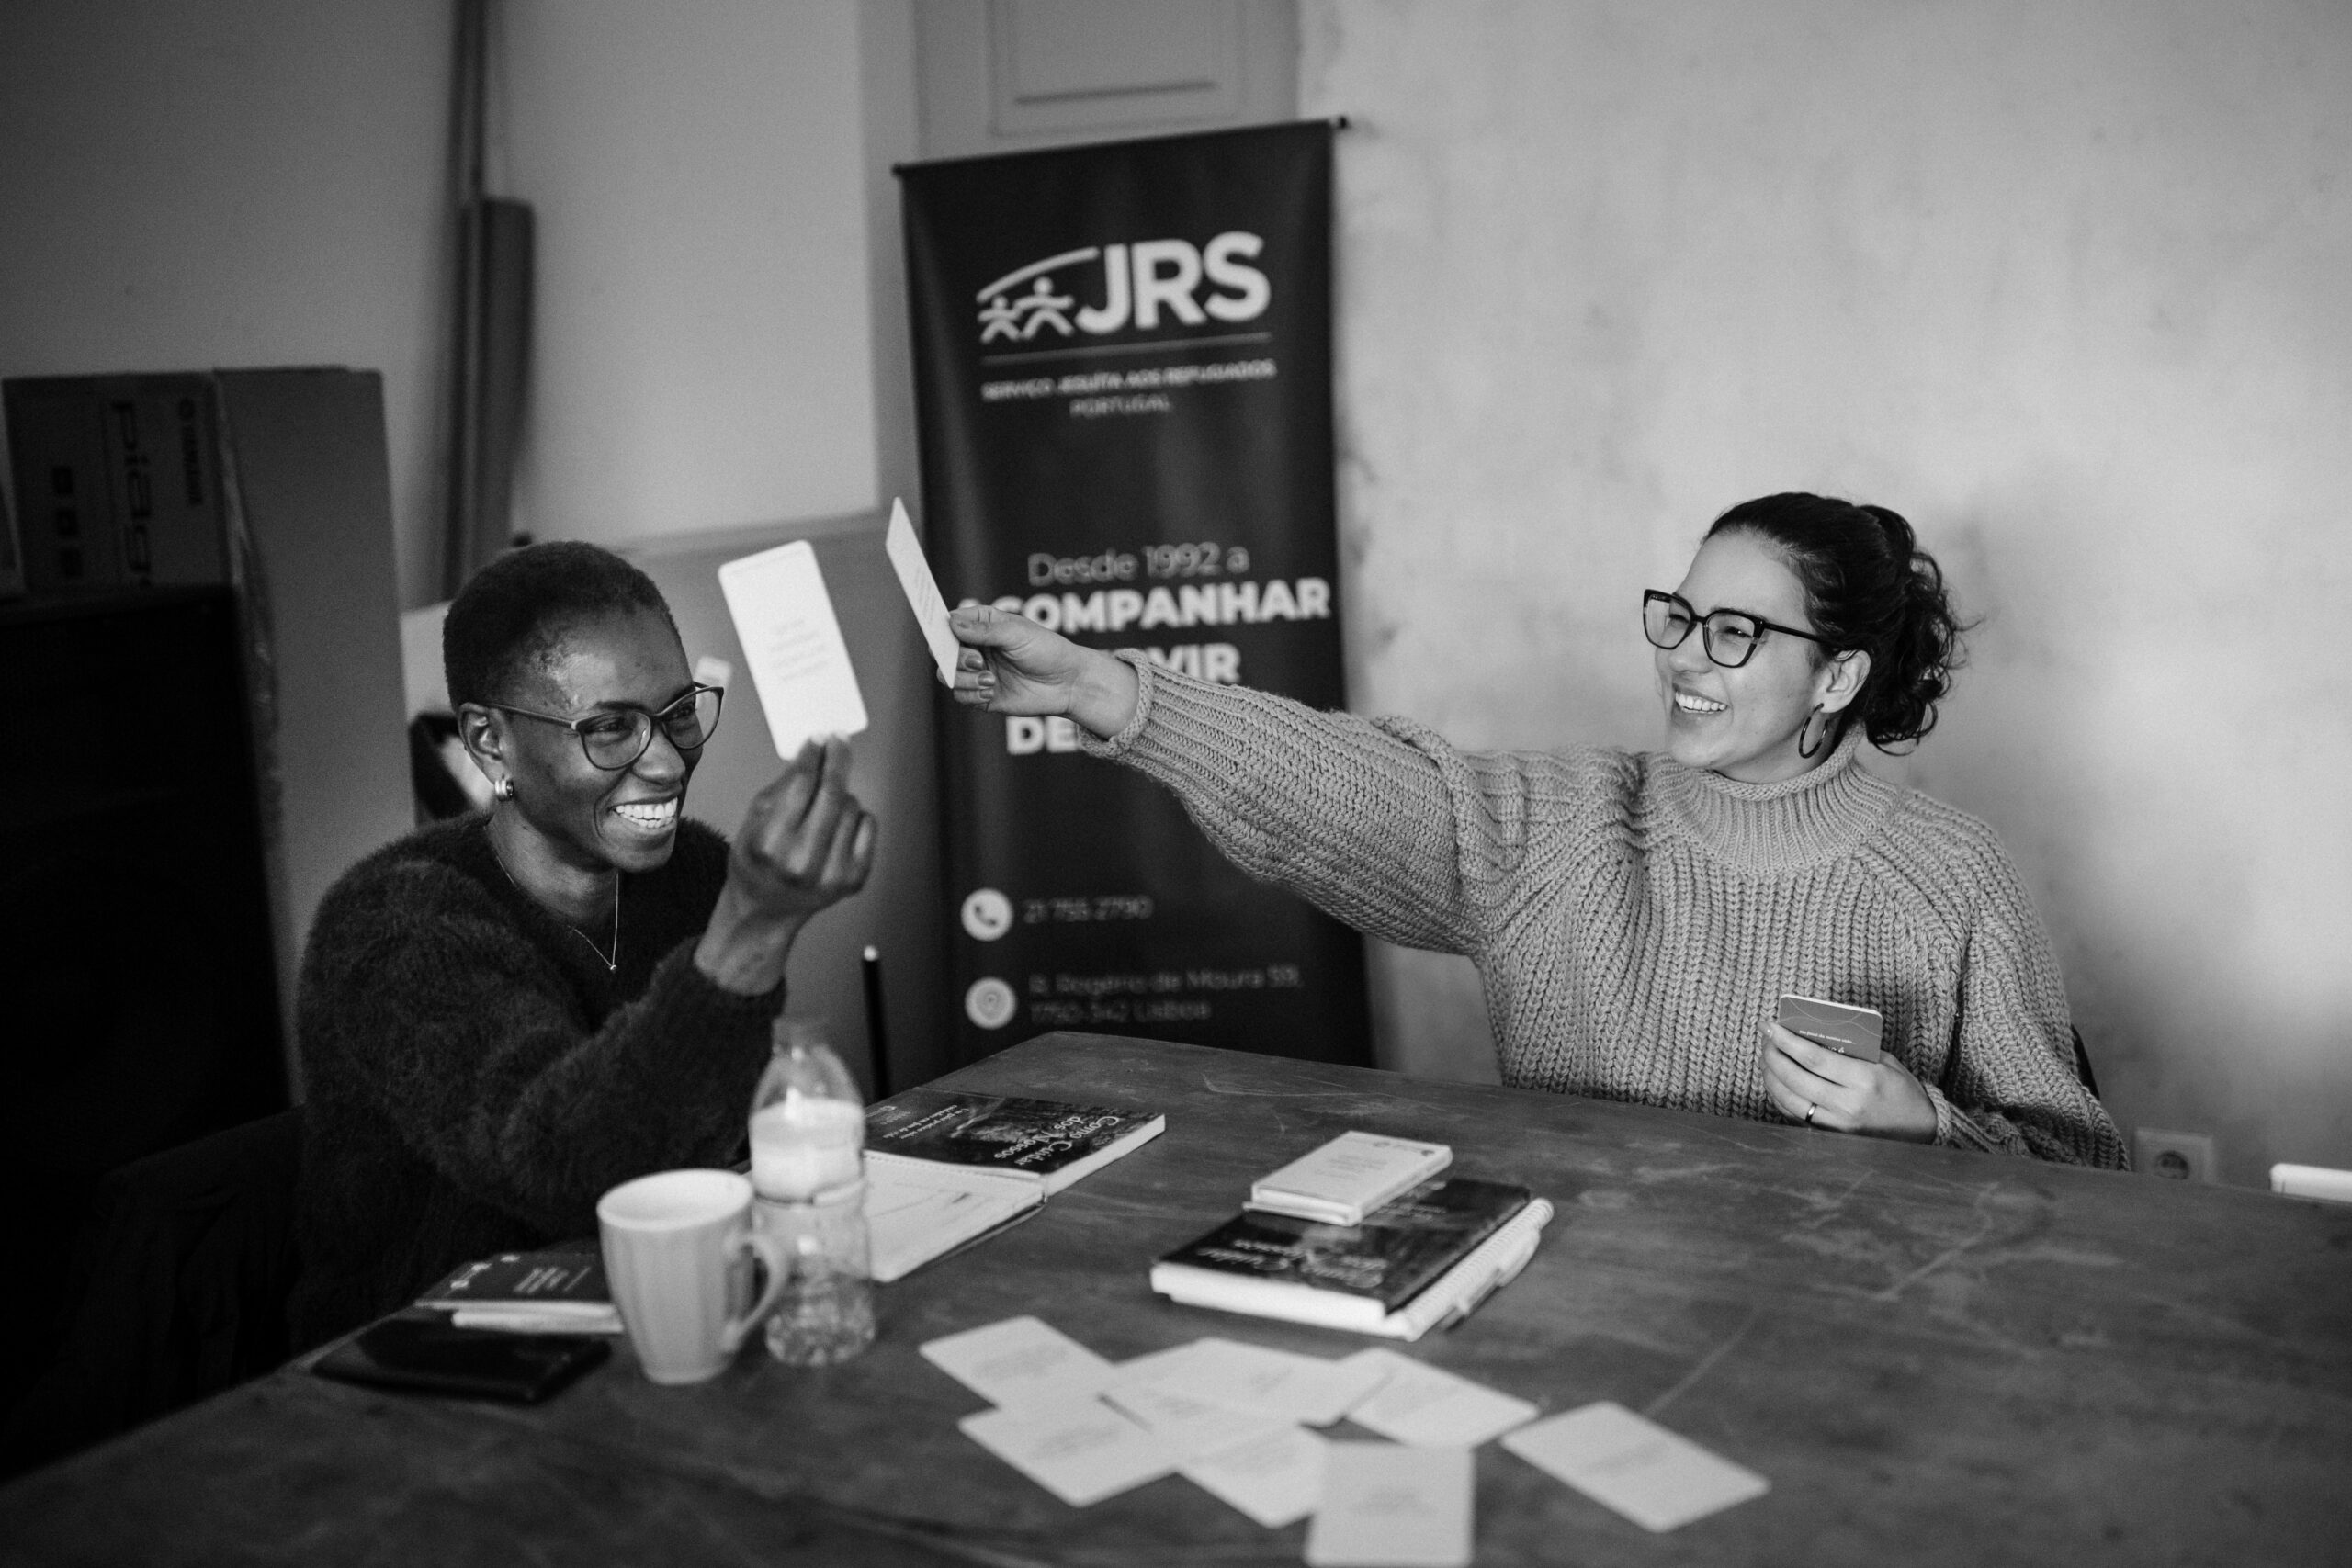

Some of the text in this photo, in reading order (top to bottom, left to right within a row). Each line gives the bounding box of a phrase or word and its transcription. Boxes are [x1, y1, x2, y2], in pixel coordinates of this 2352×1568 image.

[1075, 231, 1272, 334] JRS
[1069, 393, 1170, 418] PORTUGAL
[111, 399, 152, 588] piag
[1027, 541, 1250, 586] Desde 1992 a
[957, 577, 1331, 634] OMPANHAR
[1146, 642, 1241, 684] VIR
[994, 1116, 1083, 1158] dos Nossos
[1014, 1116, 1119, 1165] Como Cuidar
